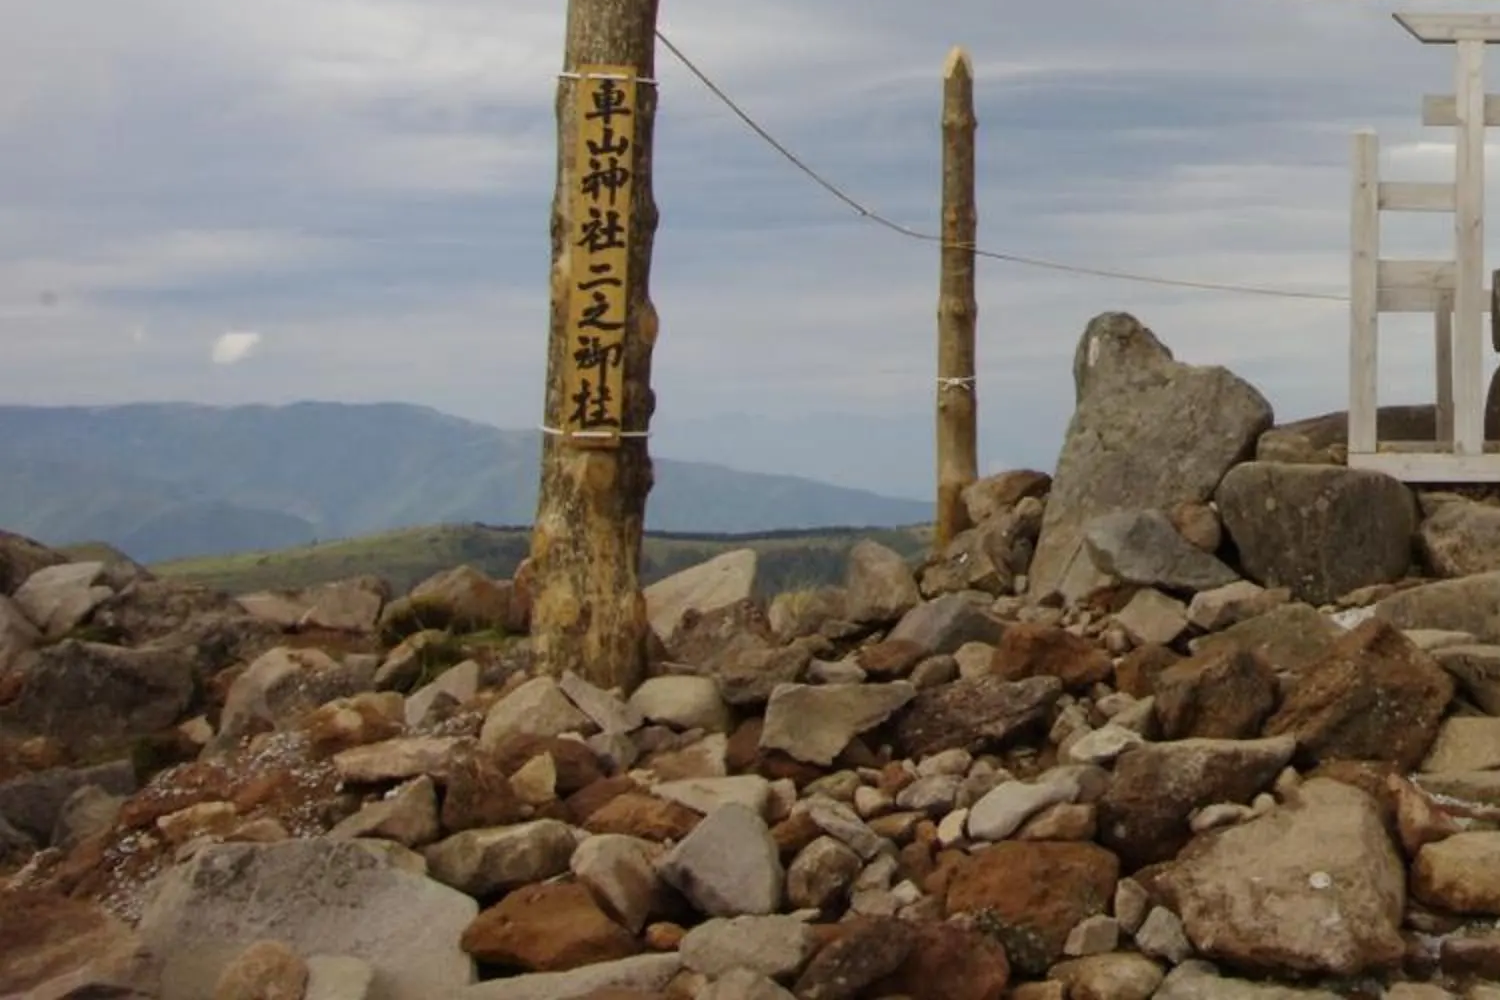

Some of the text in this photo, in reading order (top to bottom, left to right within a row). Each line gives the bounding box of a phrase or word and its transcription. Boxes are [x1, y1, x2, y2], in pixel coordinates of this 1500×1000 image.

[569, 79, 631, 430] 車山神社二之御柱
